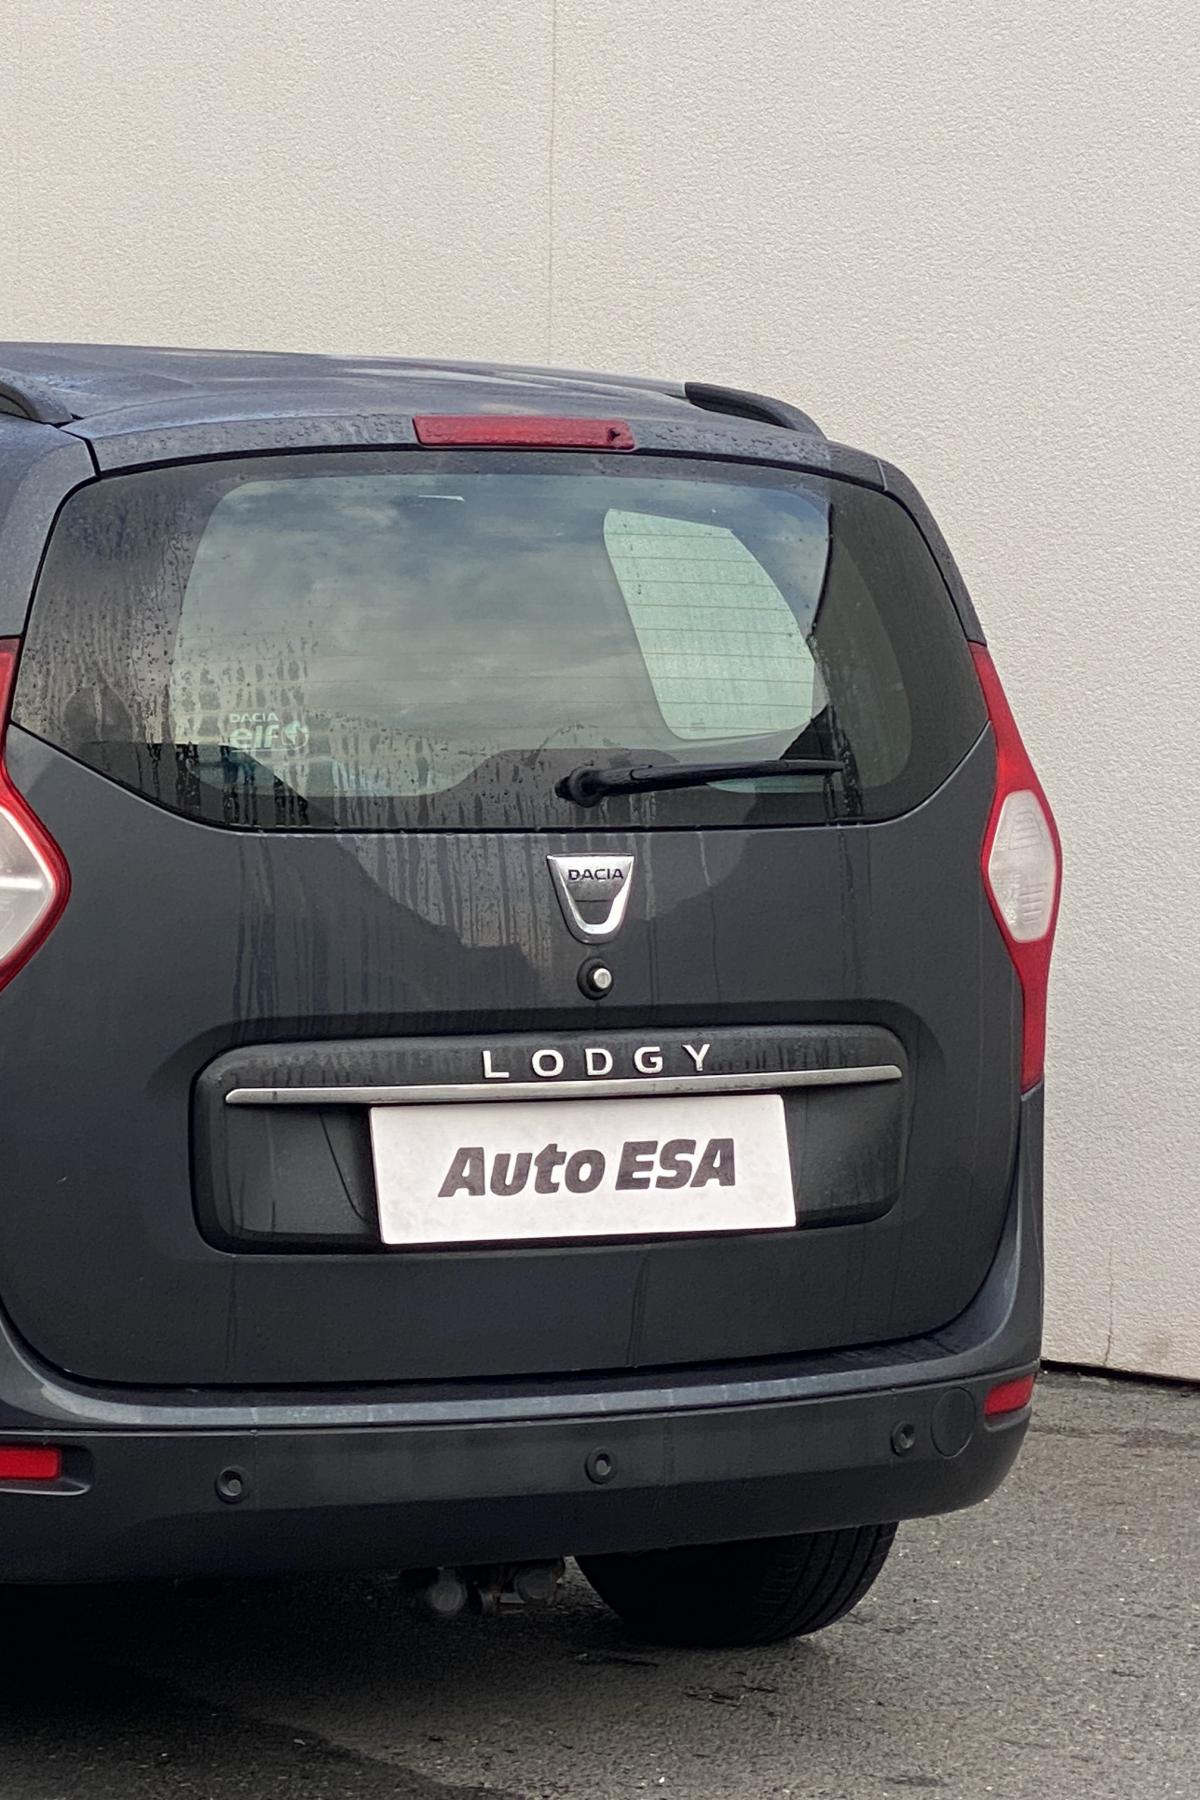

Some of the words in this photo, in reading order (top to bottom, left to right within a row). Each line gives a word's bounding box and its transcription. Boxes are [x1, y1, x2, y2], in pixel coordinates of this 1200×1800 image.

[229, 712, 279, 723] DACIA
[567, 868, 624, 881] DACIA
[482, 1043, 711, 1079] LODGY
[437, 1143, 606, 1198] Auto
[615, 1138, 736, 1191] ESA
